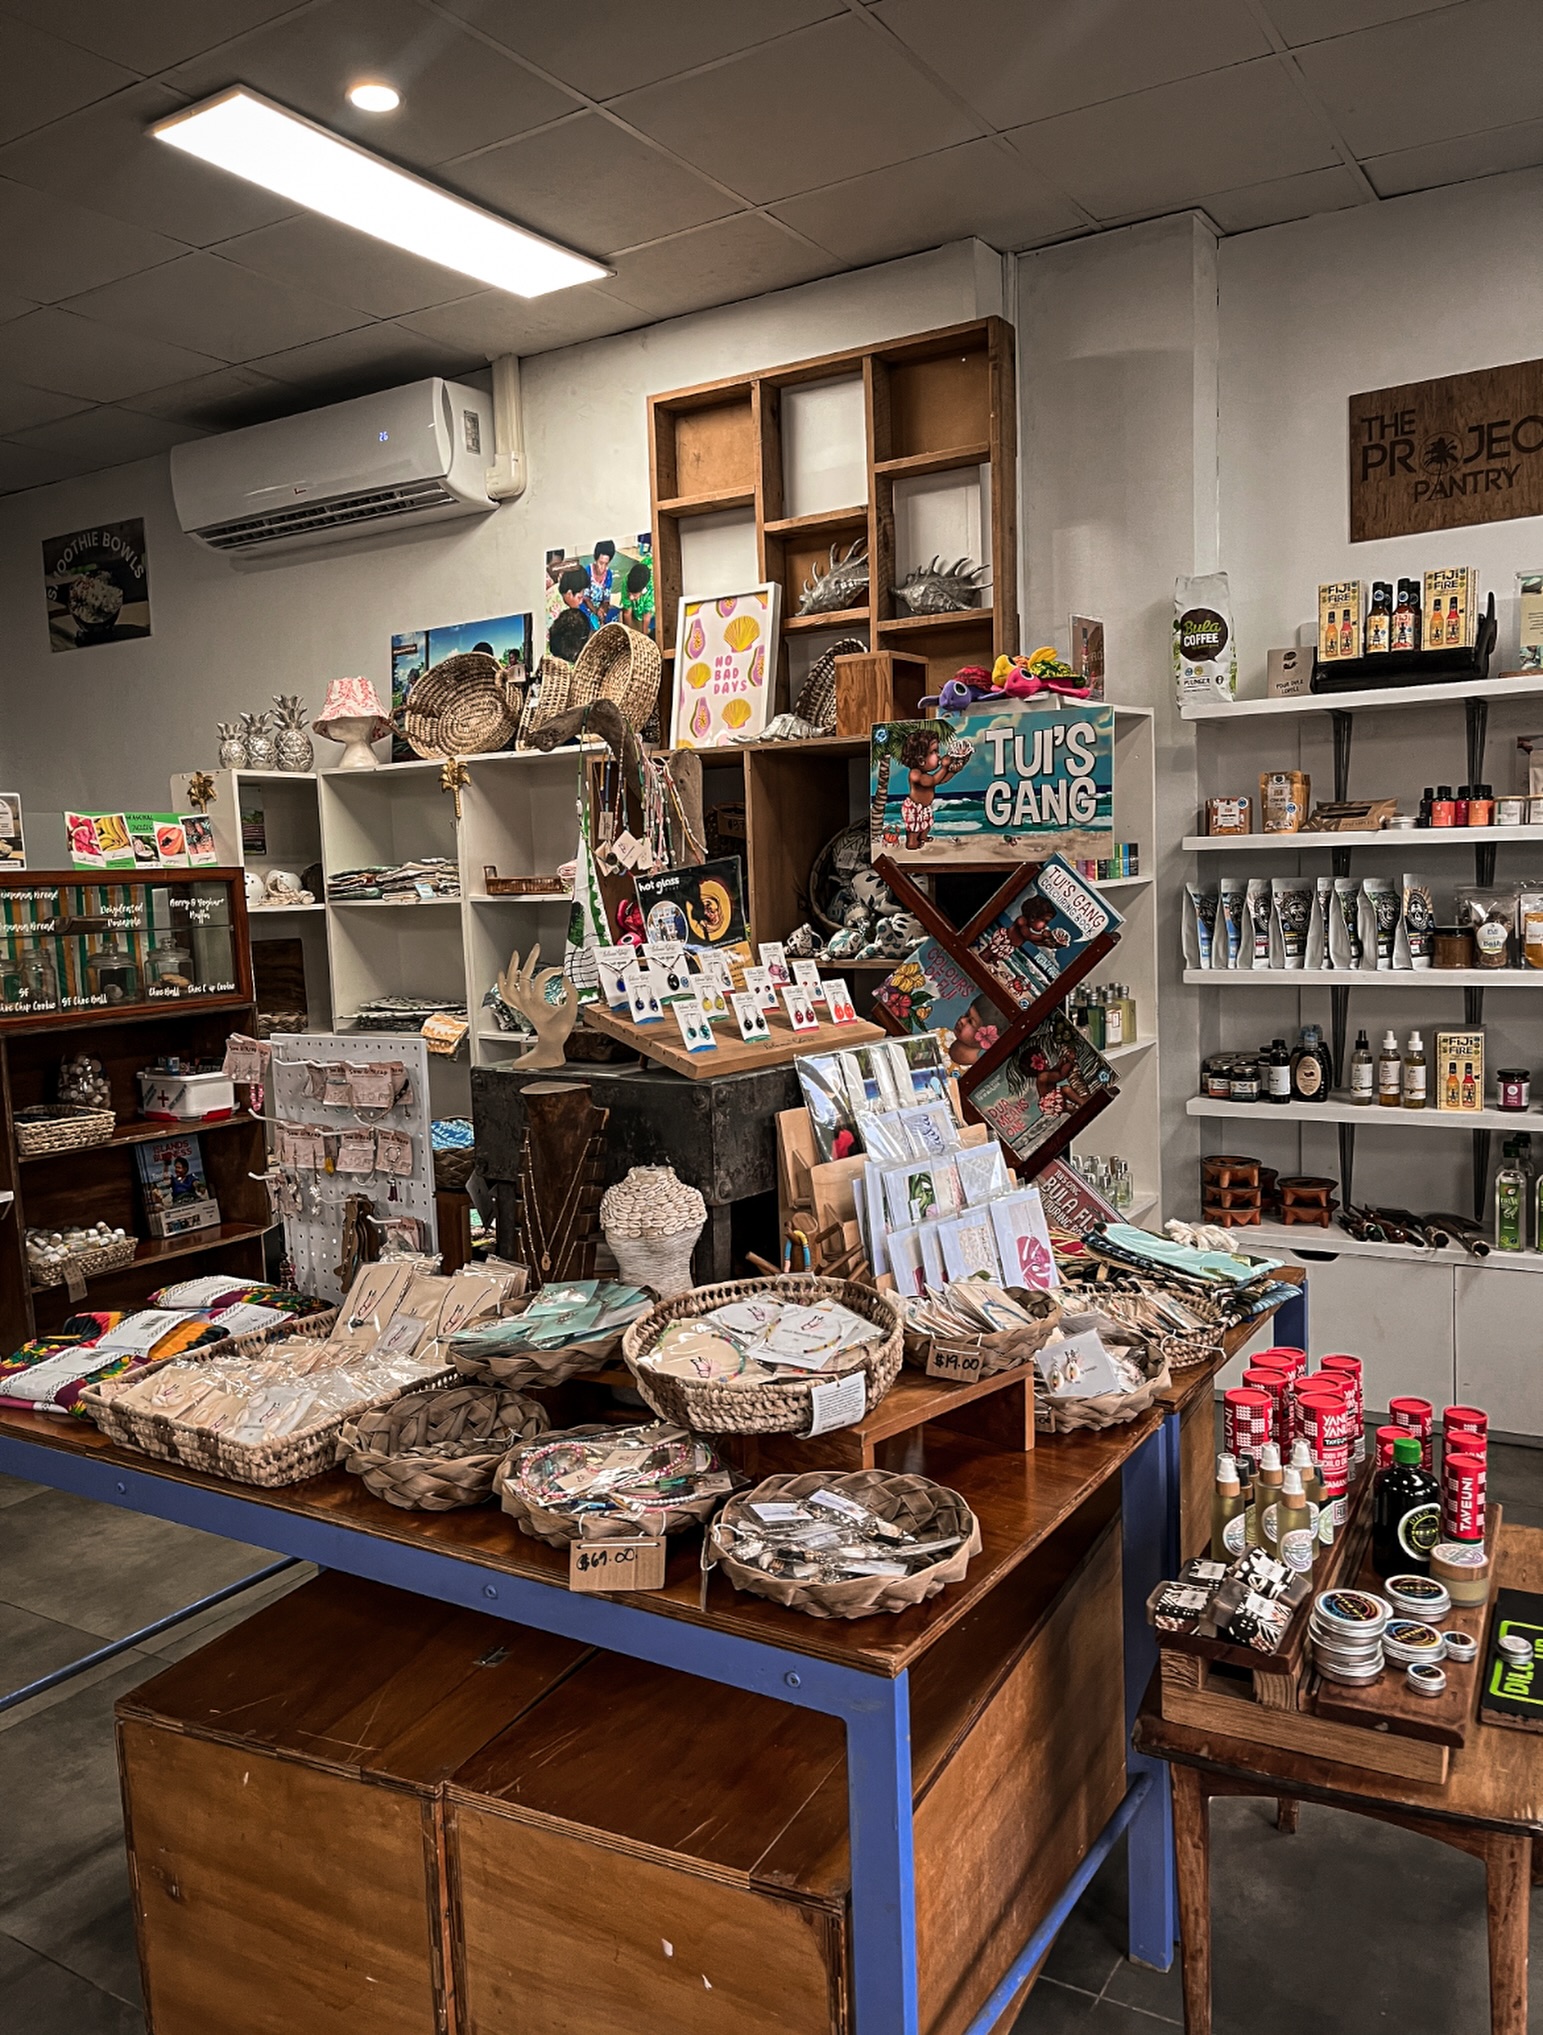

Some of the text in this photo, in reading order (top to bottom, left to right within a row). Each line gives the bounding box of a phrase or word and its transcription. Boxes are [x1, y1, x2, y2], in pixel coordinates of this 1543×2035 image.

[1361, 409, 1416, 442] THE
[1414, 464, 1522, 504] PANTRY
[103, 532, 144, 579] BOWLS
[1184, 620, 1221, 635] Bula
[1184, 633, 1219, 647] COFFEE
[715, 655, 733, 667] NO
[715, 667, 739, 681] BAD
[713, 680, 748, 695] DAYS
[984, 721, 1096, 777] TUI'S
[985, 777, 1097, 827] GANG
[638, 881, 655, 893] hot
[656, 877, 680, 895] glass
[1049, 866, 1106, 928] TUI'S GANG
[1040, 878, 1097, 935] COLOURING BOOK
[924, 965, 958, 1001] OF FIJI
[928, 946, 976, 998] COLOURS
[988, 1098, 1009, 1117] DUA
[997, 1097, 1030, 1129] MEANS
[1006, 1120, 1026, 1137] ONE
[1040, 1176, 1099, 1233] BULA FIJ
[1040, 1193, 1075, 1229] OLOURING
[933, 1353, 980, 1370] $19.00
[1225, 1407, 1234, 1449] EUNI
[1337, 1449, 1348, 1458] PUR
[1459, 1477, 1474, 1532] TAVEUNI
[576, 1547, 635, 1571] $69.00
